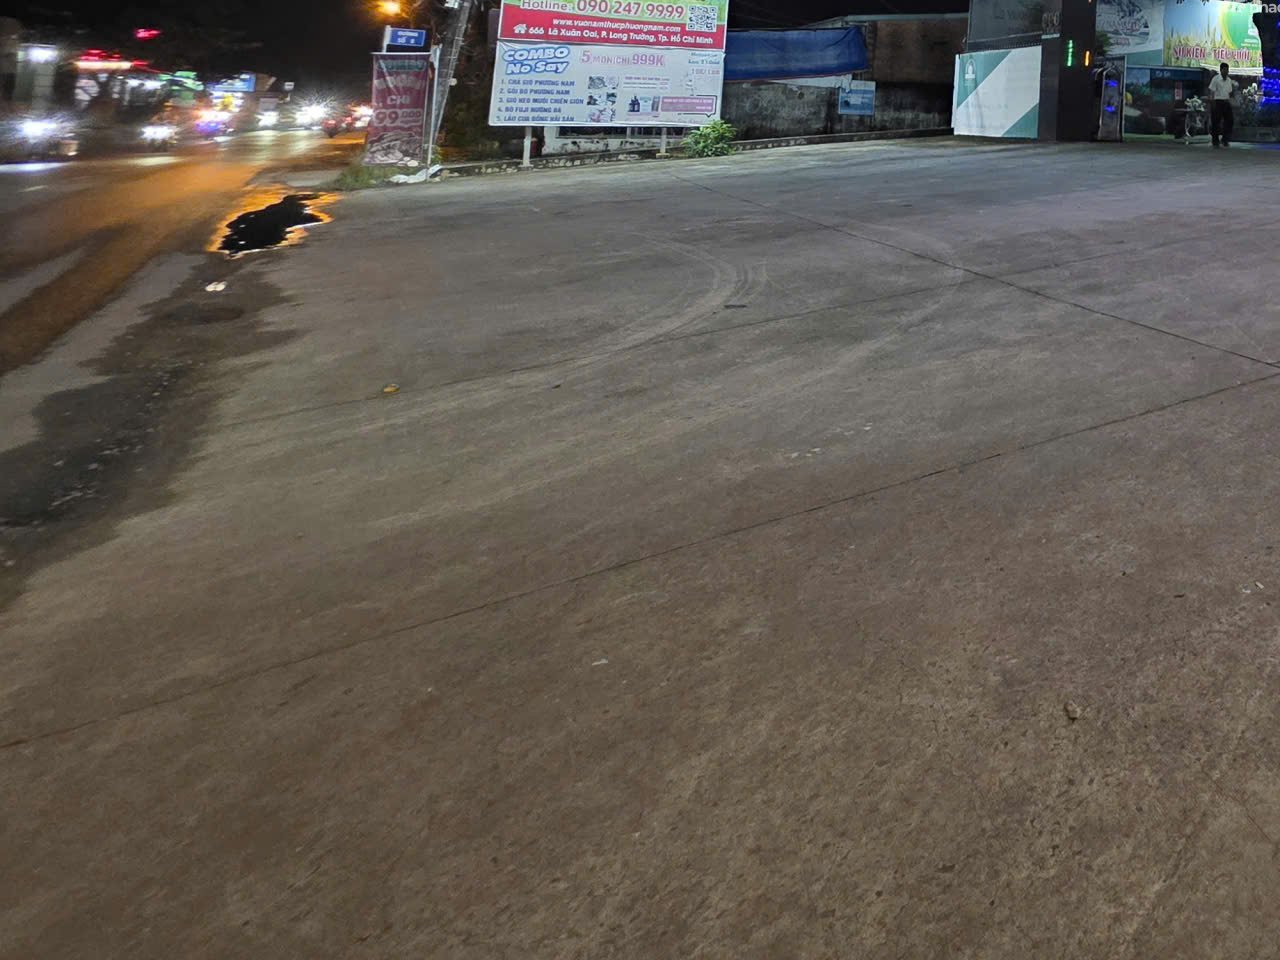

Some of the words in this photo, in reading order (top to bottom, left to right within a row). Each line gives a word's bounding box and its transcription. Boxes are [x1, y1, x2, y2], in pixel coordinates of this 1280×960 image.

[613, 0, 641, 15] 247
[645, 3, 685, 19] 9999
[552, 18, 681, 32] www.vuonamthucphuongnam.com
[528, 26, 545, 34] 666
[609, 31, 628, 41] Long
[503, 46, 570, 60] COMBO
[581, 50, 591, 63] 5
[632, 53, 664, 65] 999K
[506, 62, 531, 74] No
[534, 61, 569, 73] Say
